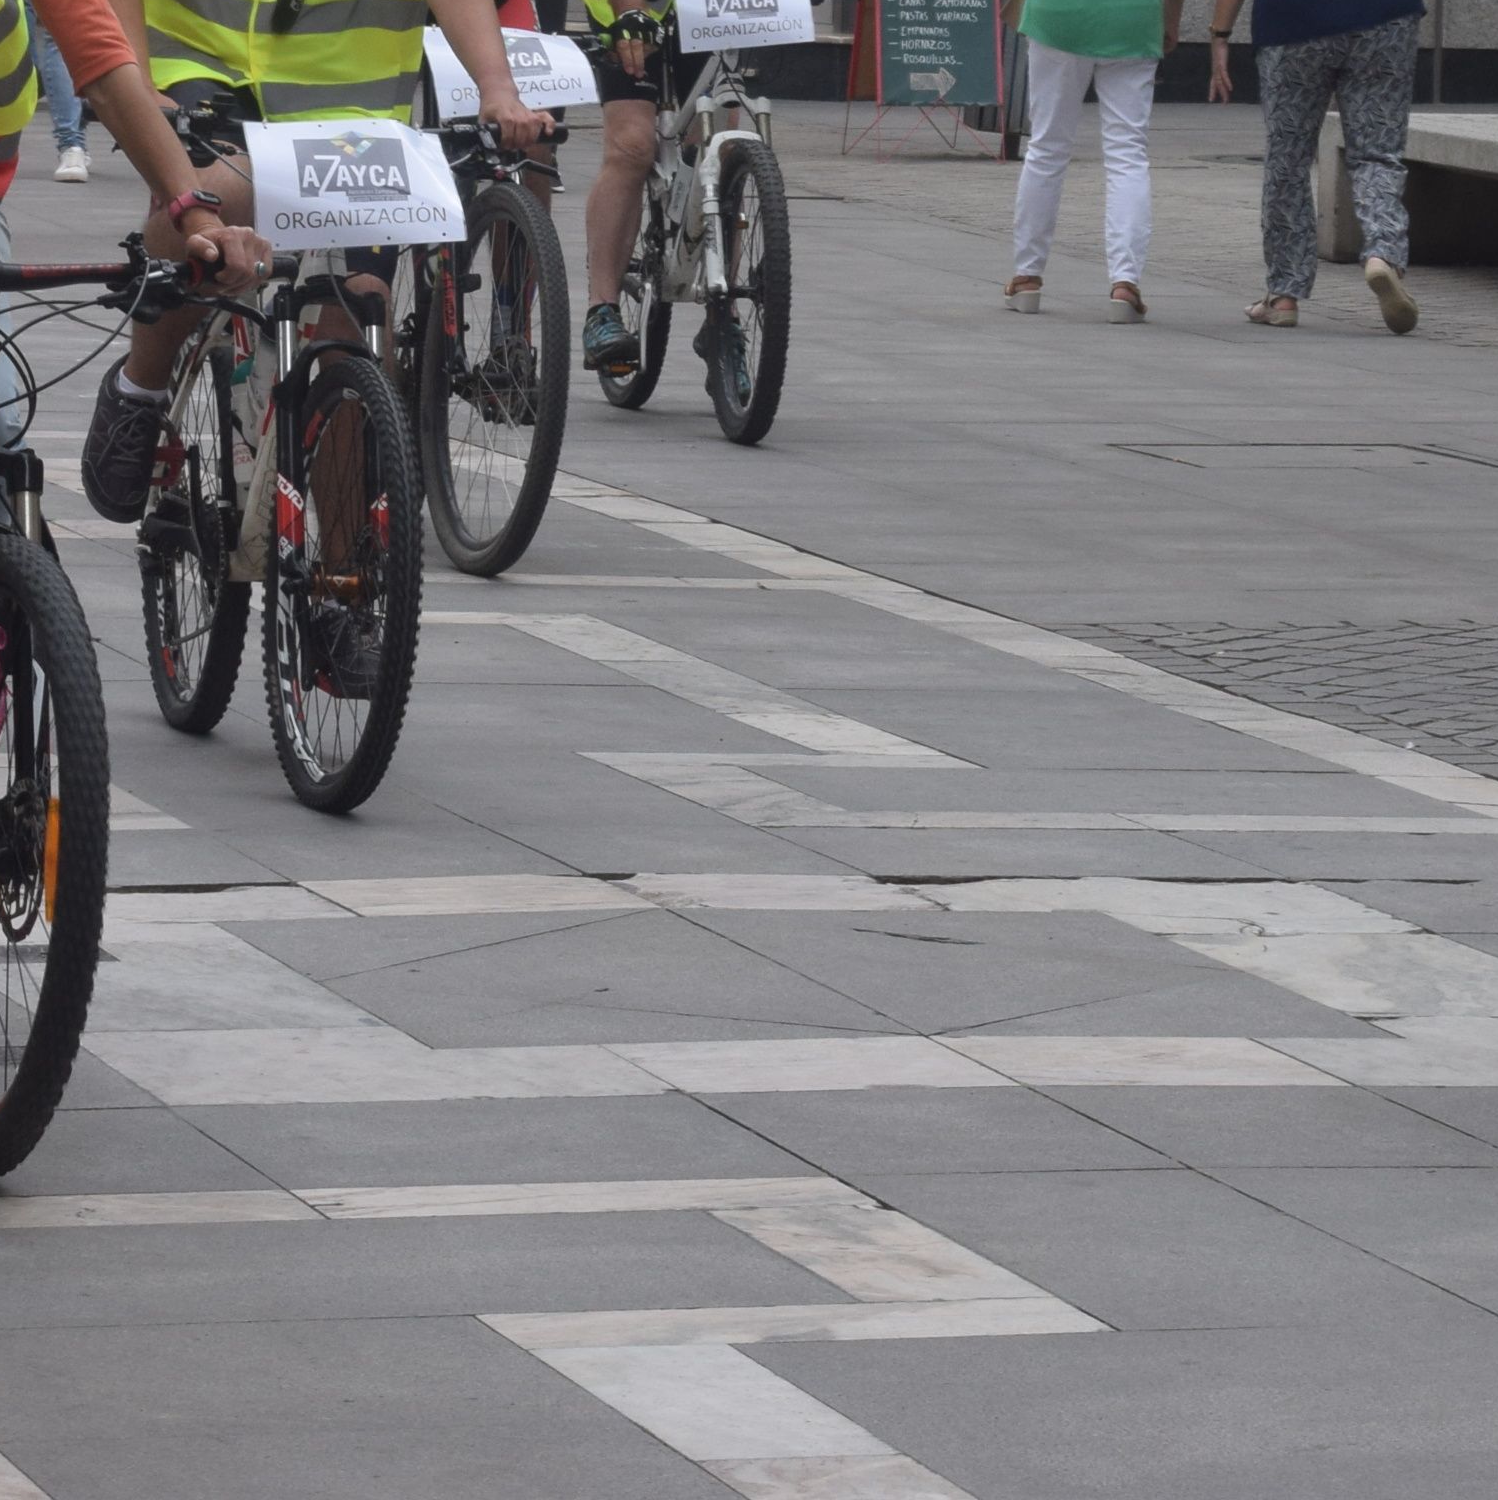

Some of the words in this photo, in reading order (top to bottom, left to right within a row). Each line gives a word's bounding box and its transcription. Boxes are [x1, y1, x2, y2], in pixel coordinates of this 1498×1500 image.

[899, 10, 929, 22] PASTAS
[691, 16, 803, 40] ORGANIZACIÓN
[900, 25, 950, 37] EMPANADAS
[900, 38, 952, 51] HORNAZOS
[507, 51, 547, 68] YCA
[302, 155, 405, 198] AZAYCA
[274, 202, 447, 230] ORGANIZACIÓN
